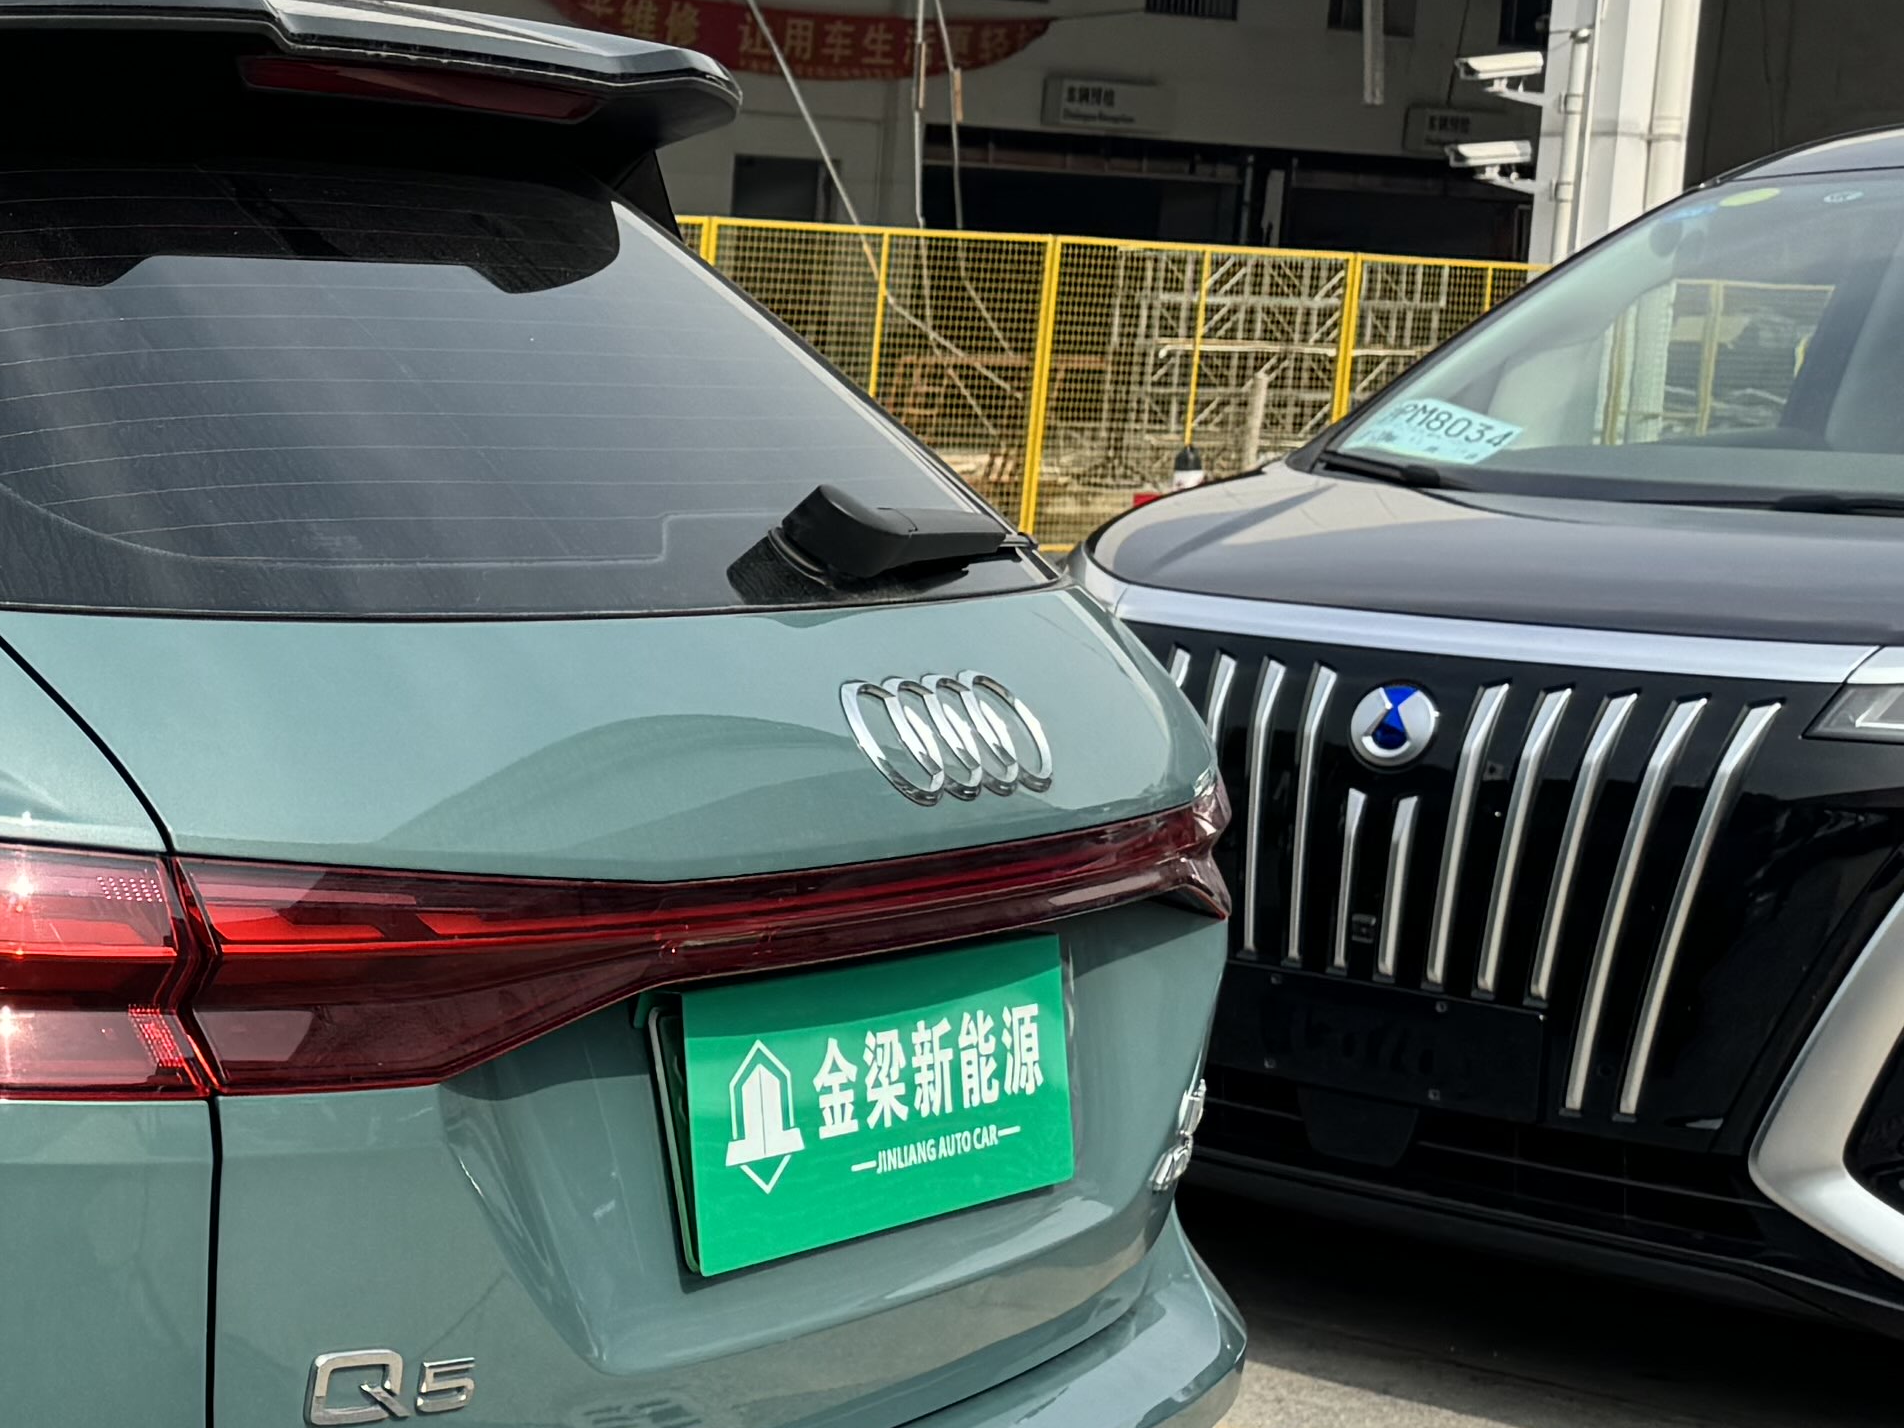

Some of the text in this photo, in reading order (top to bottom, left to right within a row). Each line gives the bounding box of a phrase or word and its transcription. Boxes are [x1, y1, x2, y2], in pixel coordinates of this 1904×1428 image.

[812, 1003, 1044, 1140] 金梁新能源
[876, 1125, 999, 1174] JINLIANG AUTO CAR
[303, 1347, 476, 1428] Q5
